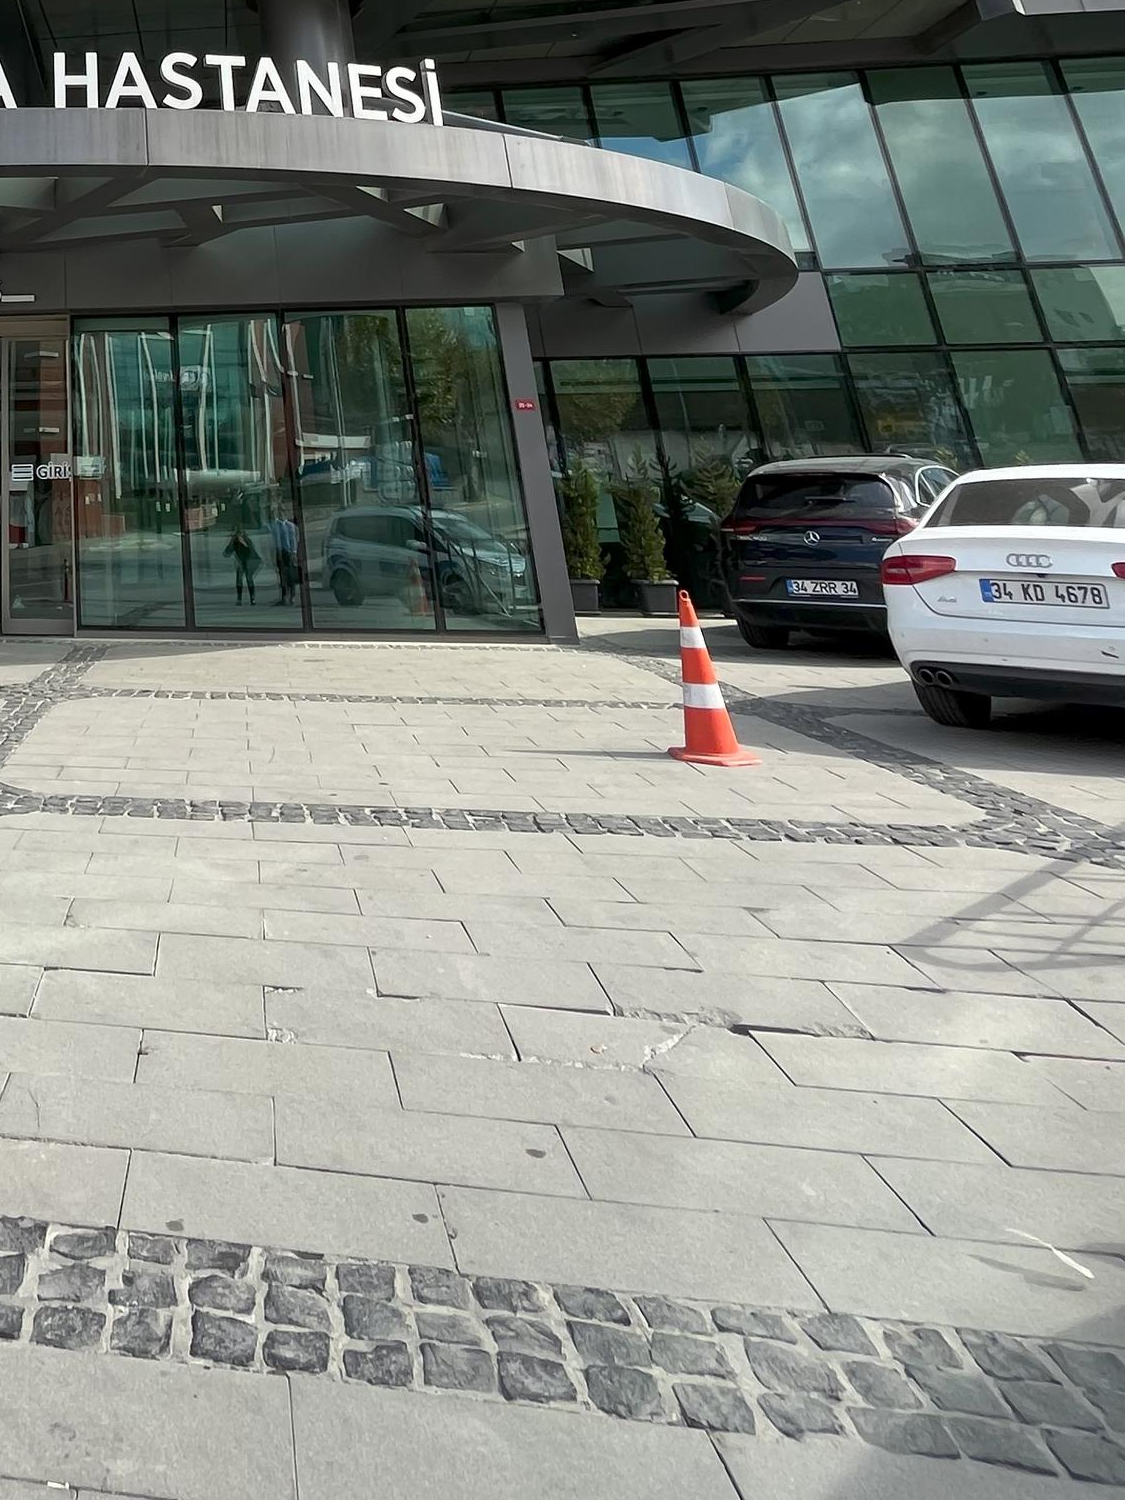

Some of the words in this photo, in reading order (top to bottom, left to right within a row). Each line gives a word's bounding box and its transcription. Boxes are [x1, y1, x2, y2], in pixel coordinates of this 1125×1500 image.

[53, 51, 444, 126] HASTANESİ
[792, 581, 808, 593] 34
[810, 581, 838, 594] ZRR
[842, 582, 857, 595] 34
[991, 582, 1013, 600] 34
[1021, 583, 1045, 602] KD
[1055, 585, 1103, 605] 4678
